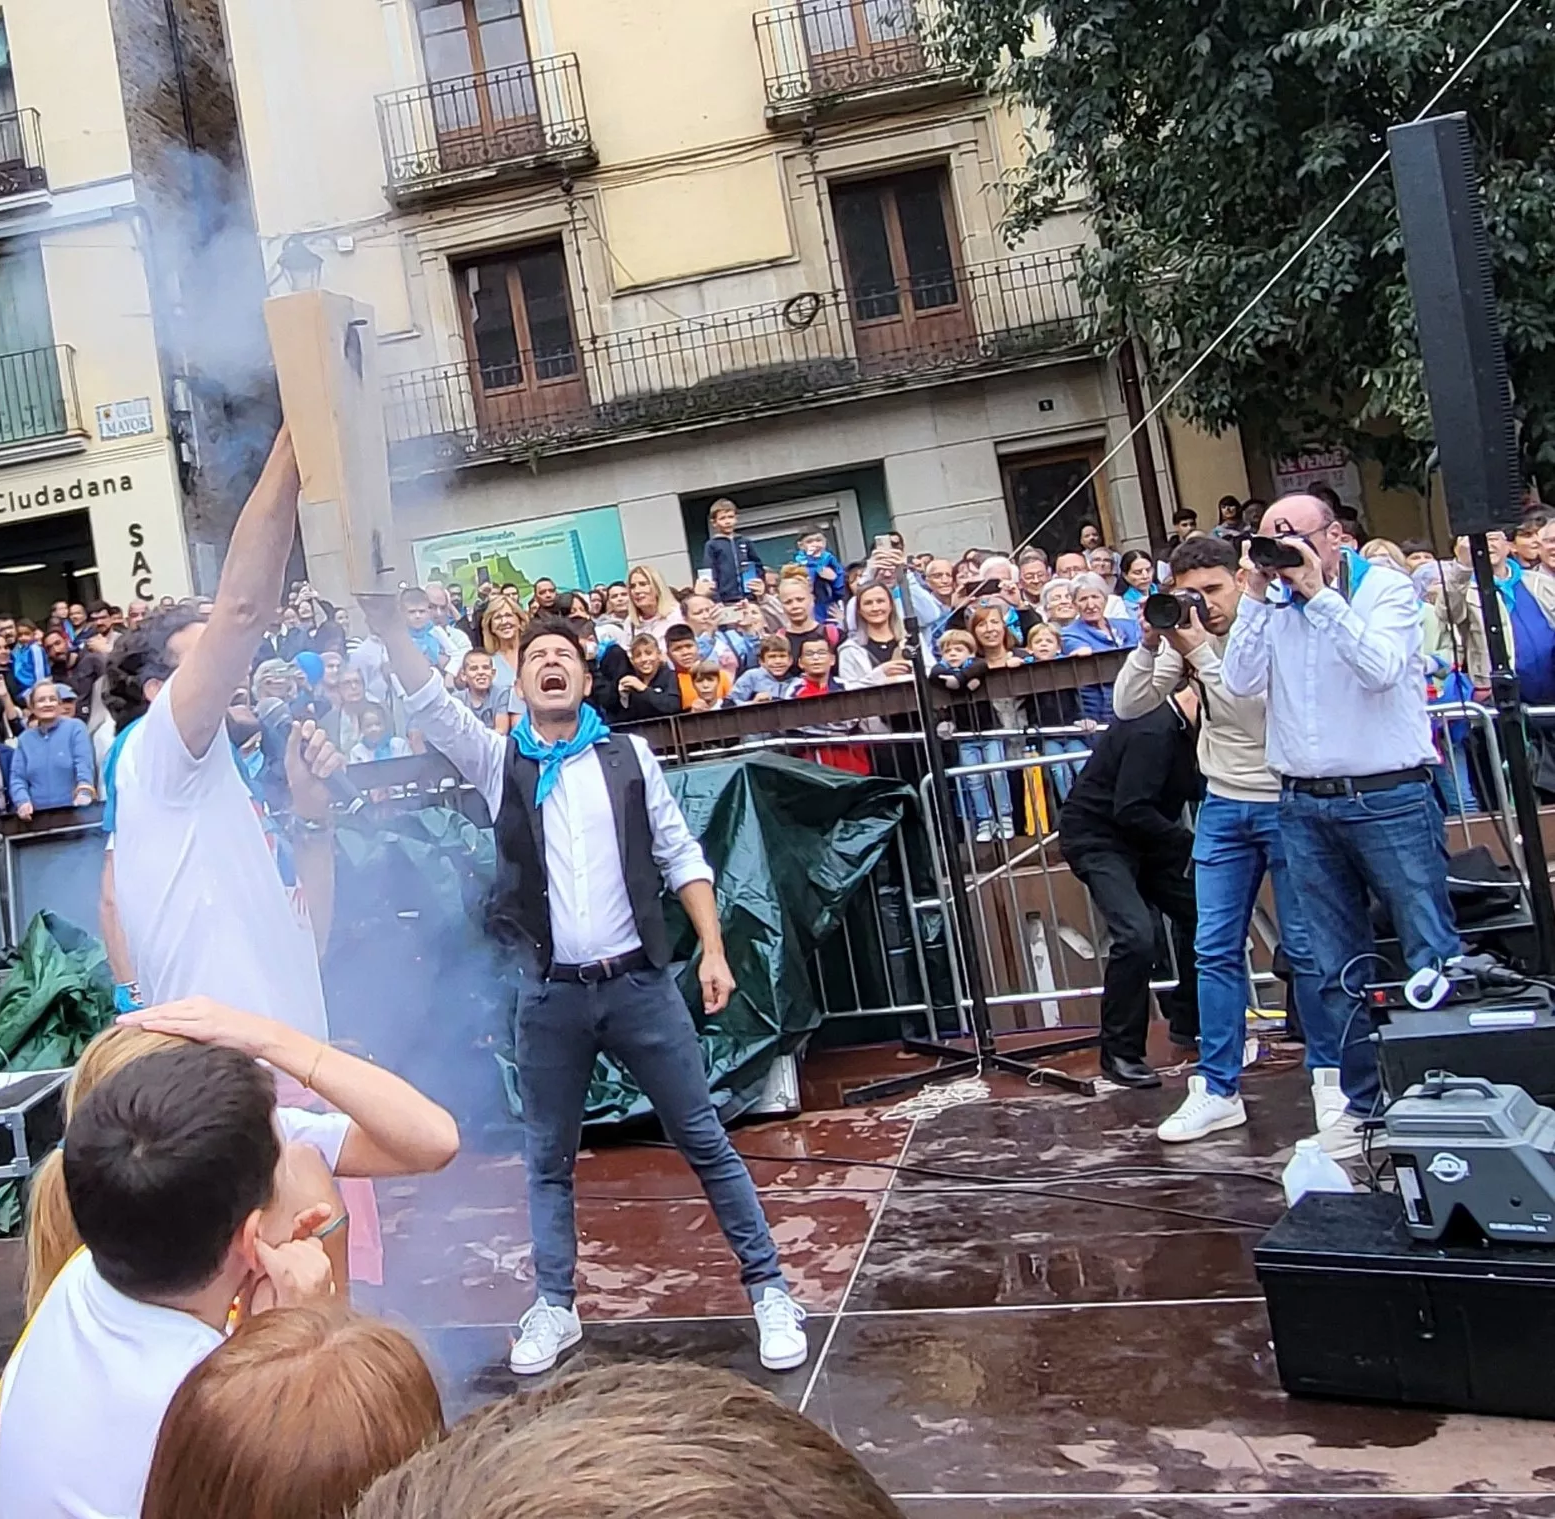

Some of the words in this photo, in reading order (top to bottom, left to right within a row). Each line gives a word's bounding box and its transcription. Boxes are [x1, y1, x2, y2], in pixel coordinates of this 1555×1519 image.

[105, 416, 148, 433] MAYOR
[1298, 450, 1344, 470] VENDE
[128, 523, 154, 601] SAC
